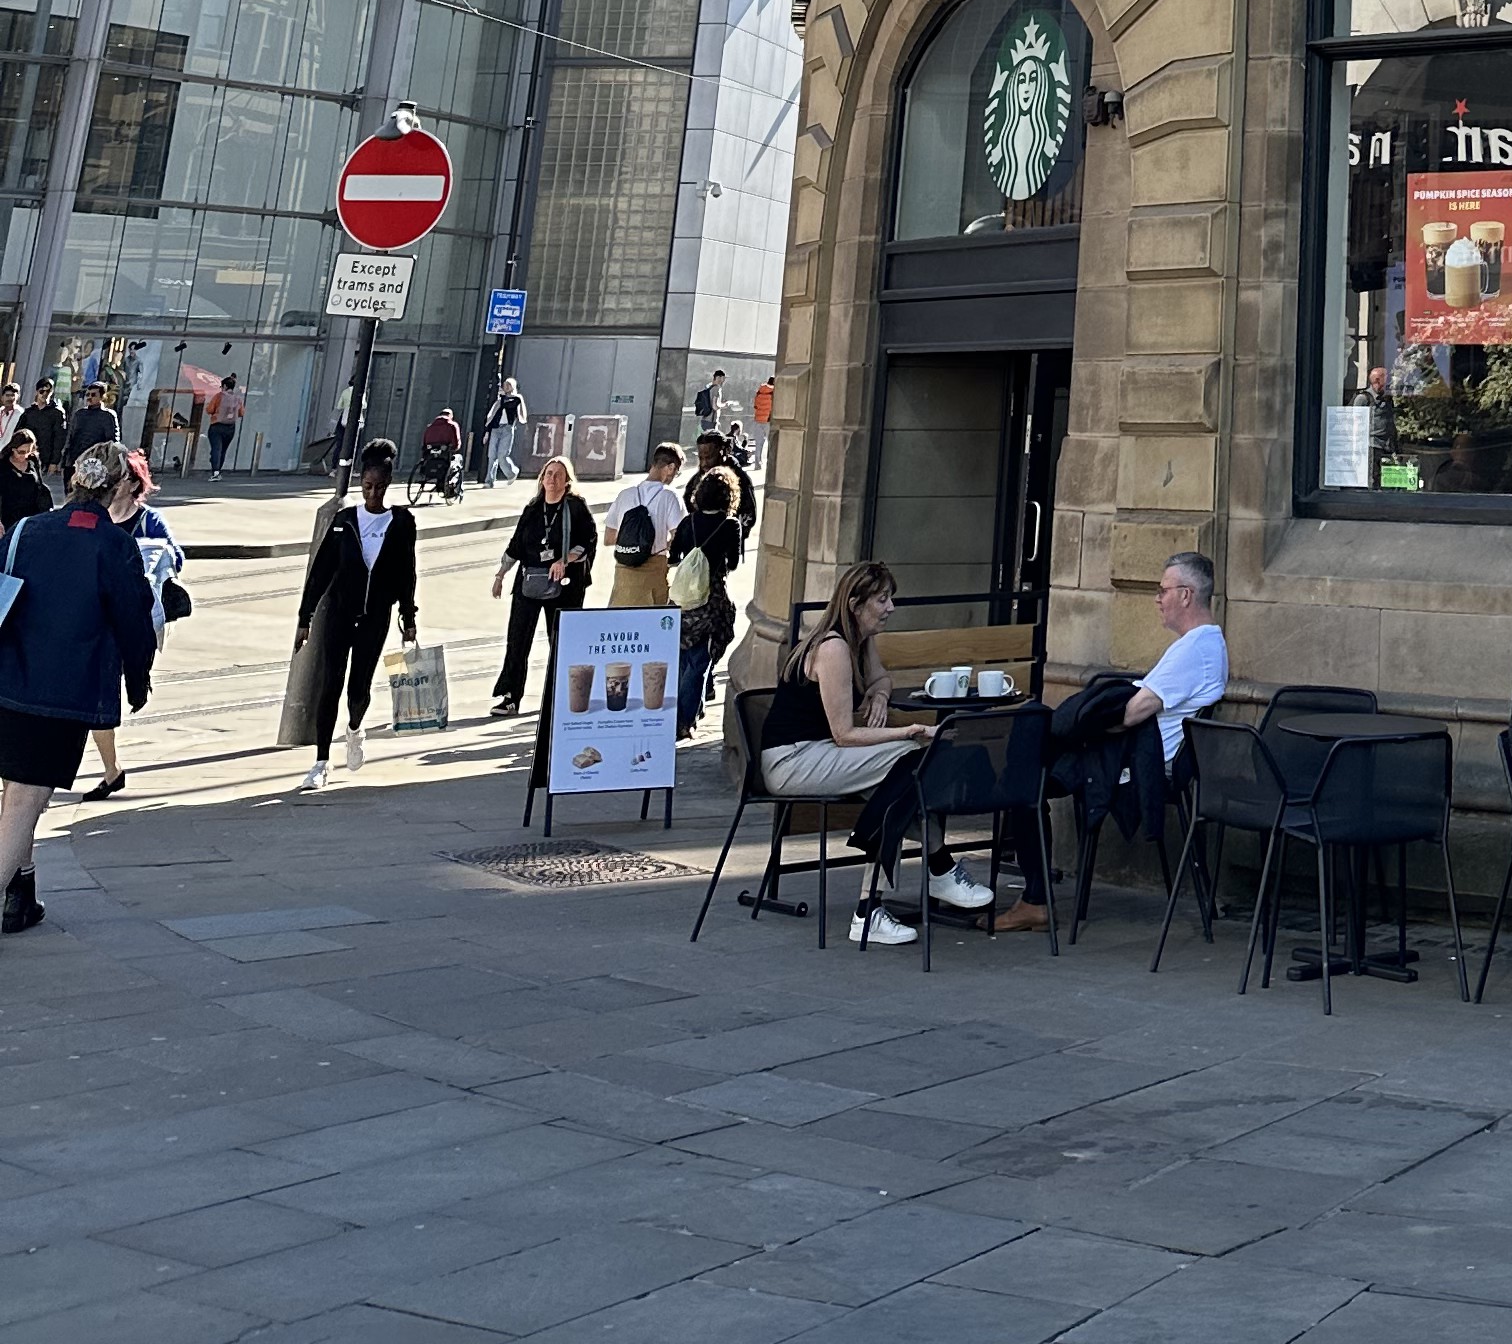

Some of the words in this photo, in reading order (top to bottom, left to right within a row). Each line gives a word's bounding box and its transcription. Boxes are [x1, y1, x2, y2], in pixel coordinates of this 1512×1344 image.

[1414, 189, 1456, 200] PUMPKIN
[1456, 189, 1480, 199] SPICE
[1448, 202, 1458, 211] IS
[1458, 201, 1481, 211] HERE
[351, 261, 397, 277] Except
[337, 277, 375, 292] trams
[378, 281, 404, 294] and
[345, 296, 387, 310] cycles
[600, 632, 640, 642] SAVOUR
[589, 645, 606, 655] THE
[611, 643, 650, 654] SEASON
